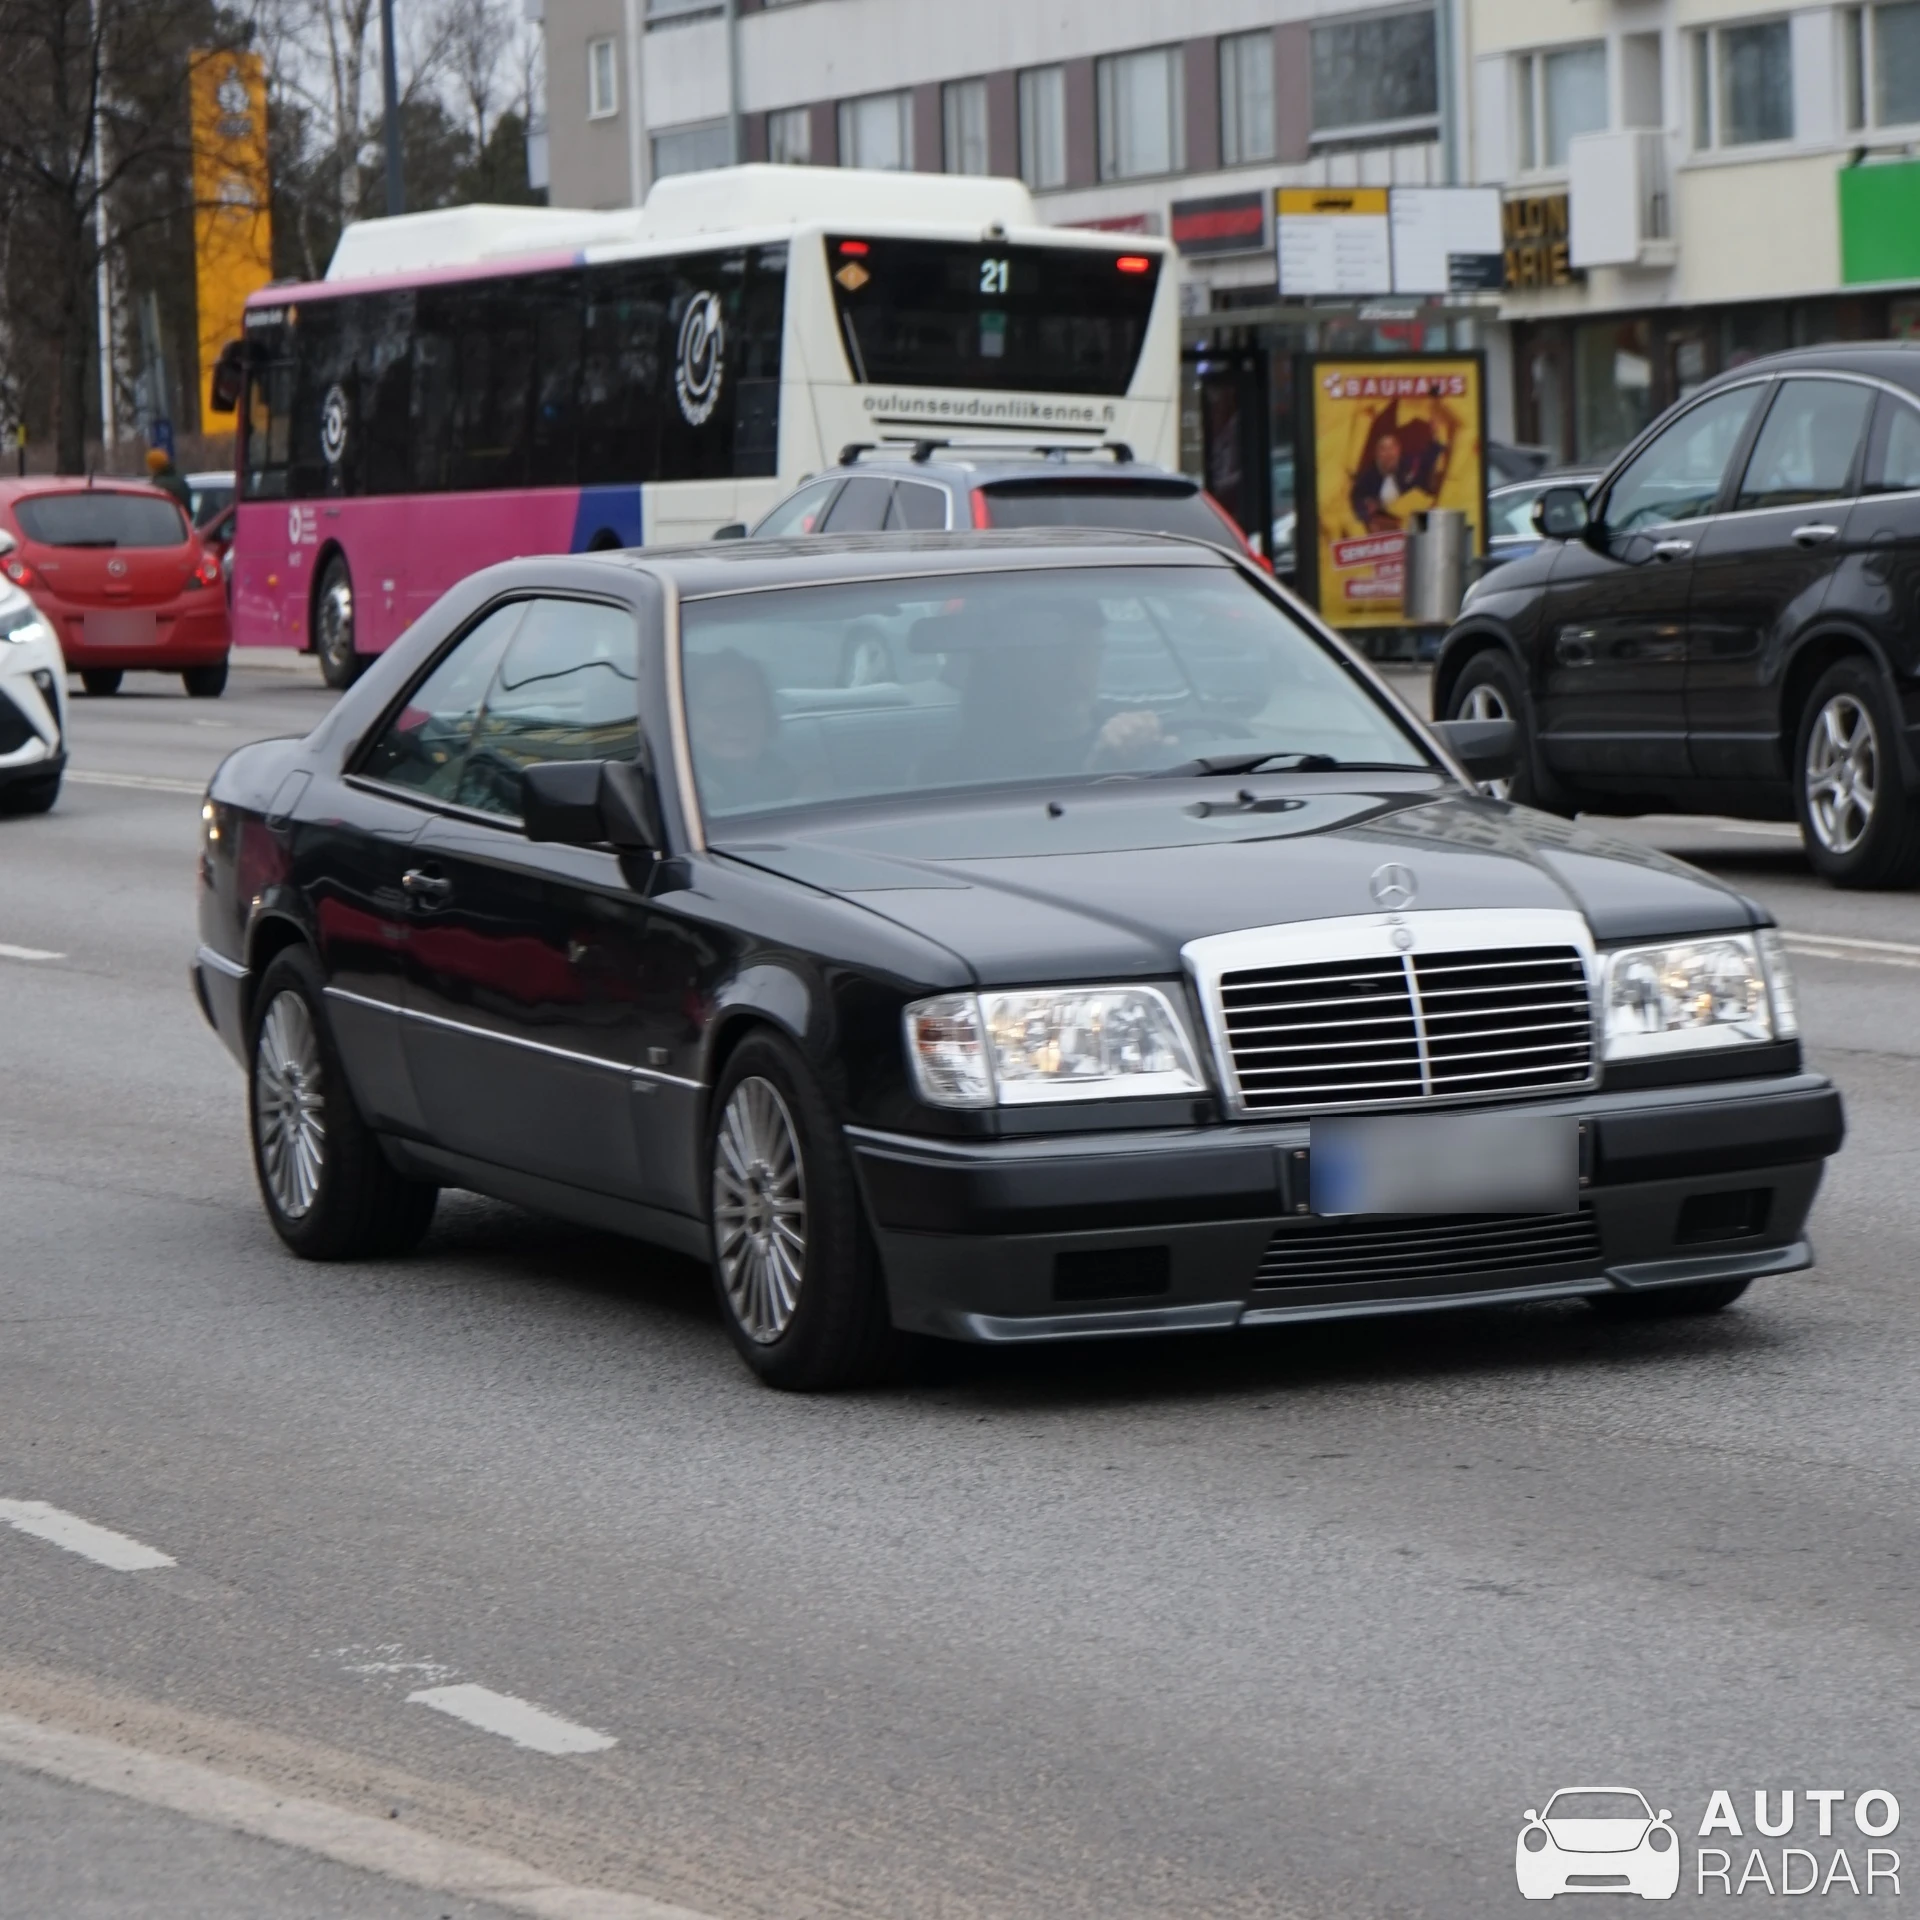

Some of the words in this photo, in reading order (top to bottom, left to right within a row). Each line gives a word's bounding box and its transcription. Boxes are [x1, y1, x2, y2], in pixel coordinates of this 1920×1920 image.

[979, 259, 1010, 293] 21
[1345, 375, 1464, 398] BAUHAUS
[862, 393, 1116, 422] oulunseudunliikenne.fi
